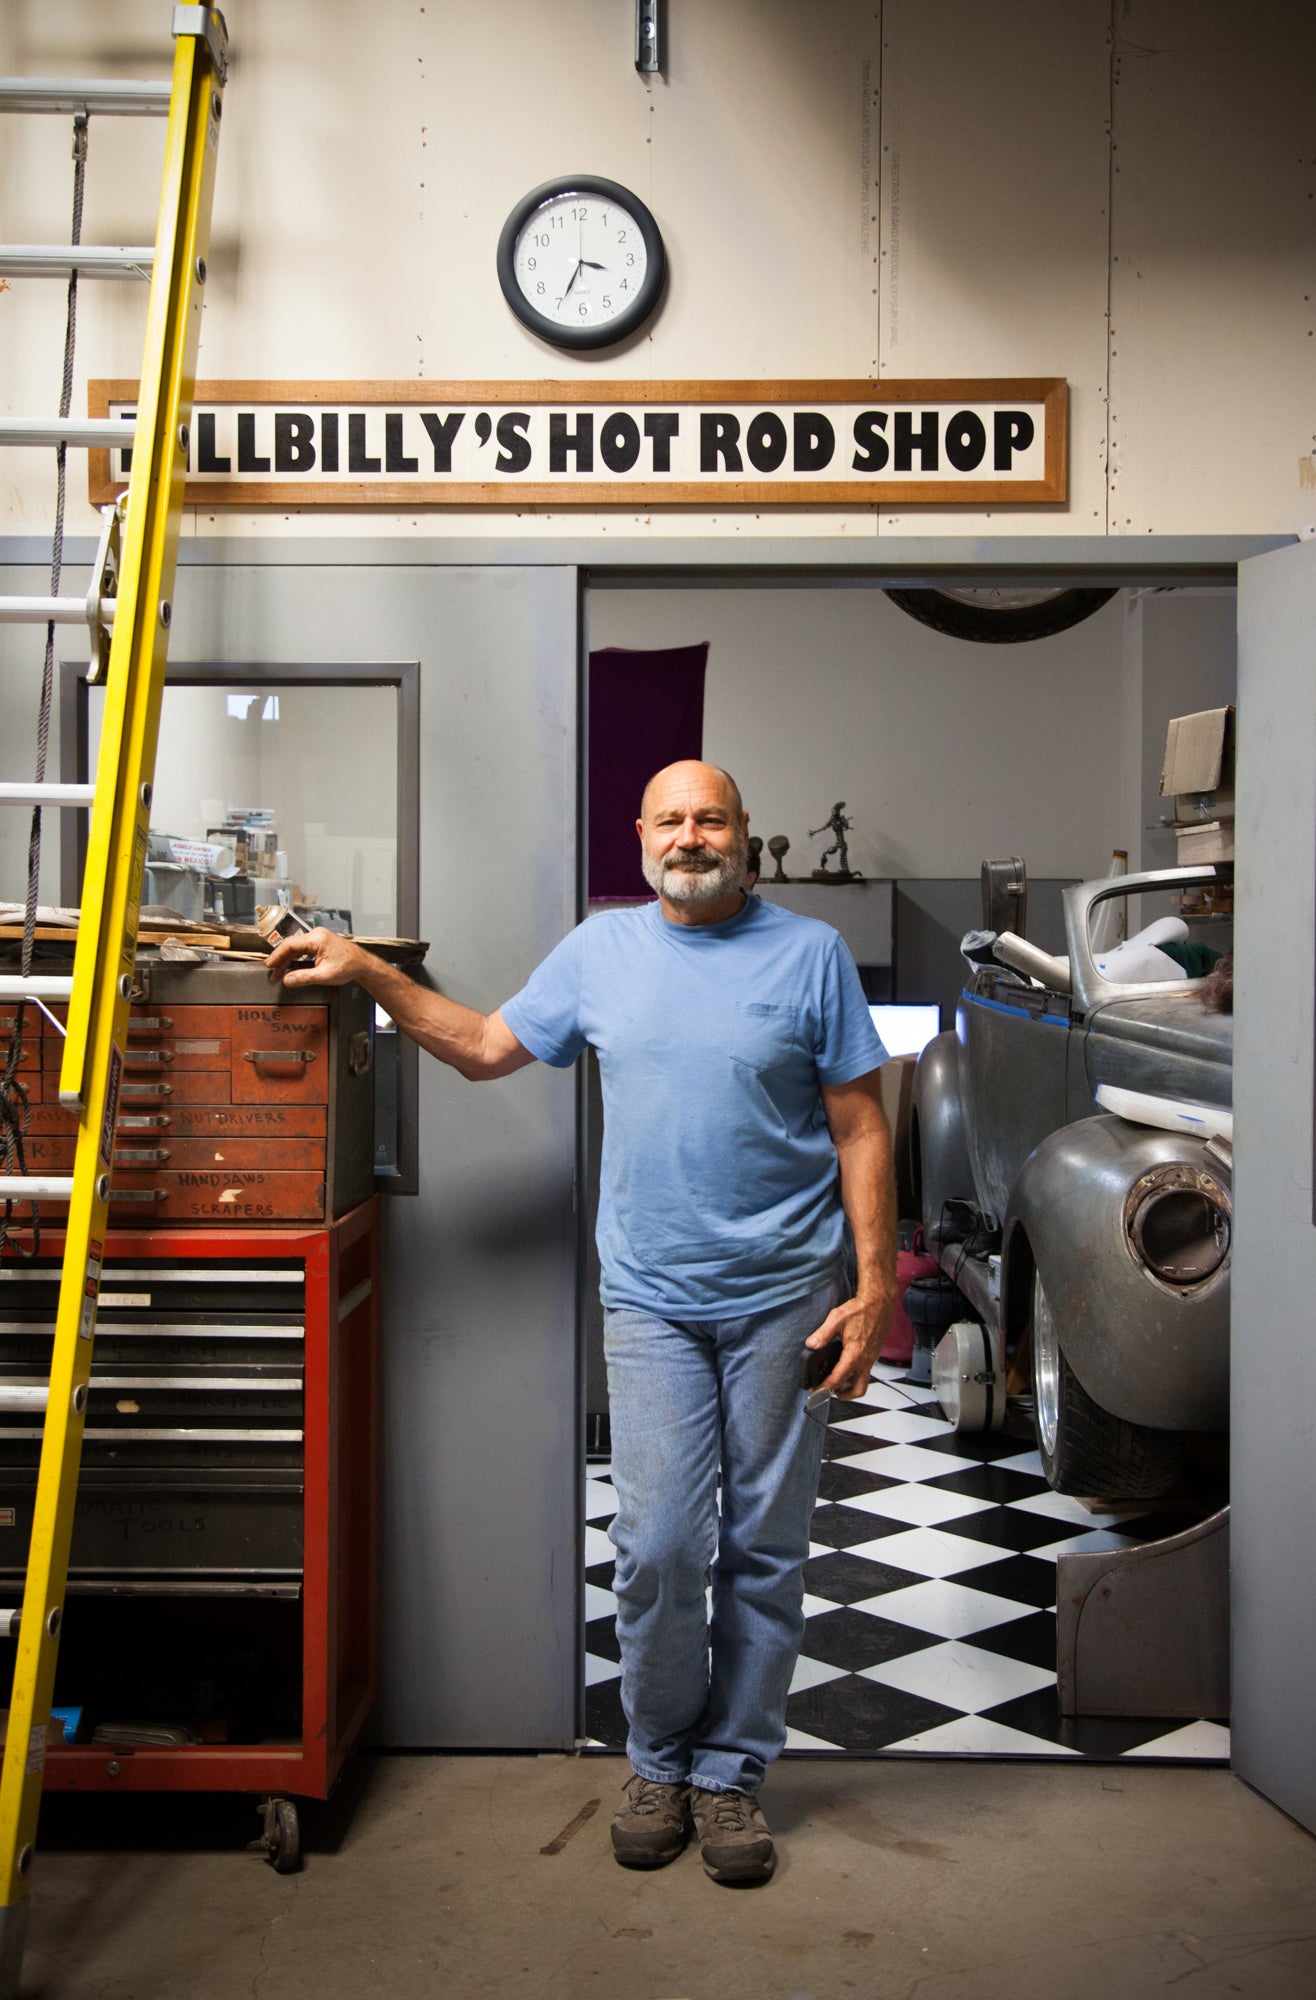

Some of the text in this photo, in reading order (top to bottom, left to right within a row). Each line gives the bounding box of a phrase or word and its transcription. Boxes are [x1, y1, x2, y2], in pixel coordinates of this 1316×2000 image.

[571, 208, 588, 221] 12
[601, 214, 607, 227] 1
[550, 216, 564, 229] 11
[534, 233, 550, 247] 10
[617, 230, 627, 244] 2
[528, 257, 537, 271] 9
[625, 253, 635, 266] 3
[536, 281, 546, 295] 8
[619, 278, 629, 290] 4
[555, 297, 563, 310] 7
[602, 295, 612, 309] 5
[578, 303, 588, 316] 6
[121, 410, 1035, 474] LLBILLY'S HOT ROD SHOP
[237, 1010, 282, 1022] HOLE
[271, 1023, 321, 1034] SAWS
[218, 1111, 286, 1126] DRIVERS
[191, 1203, 273, 1216] SCRAPERS
[114, 1517, 206, 1539] TOOLS
